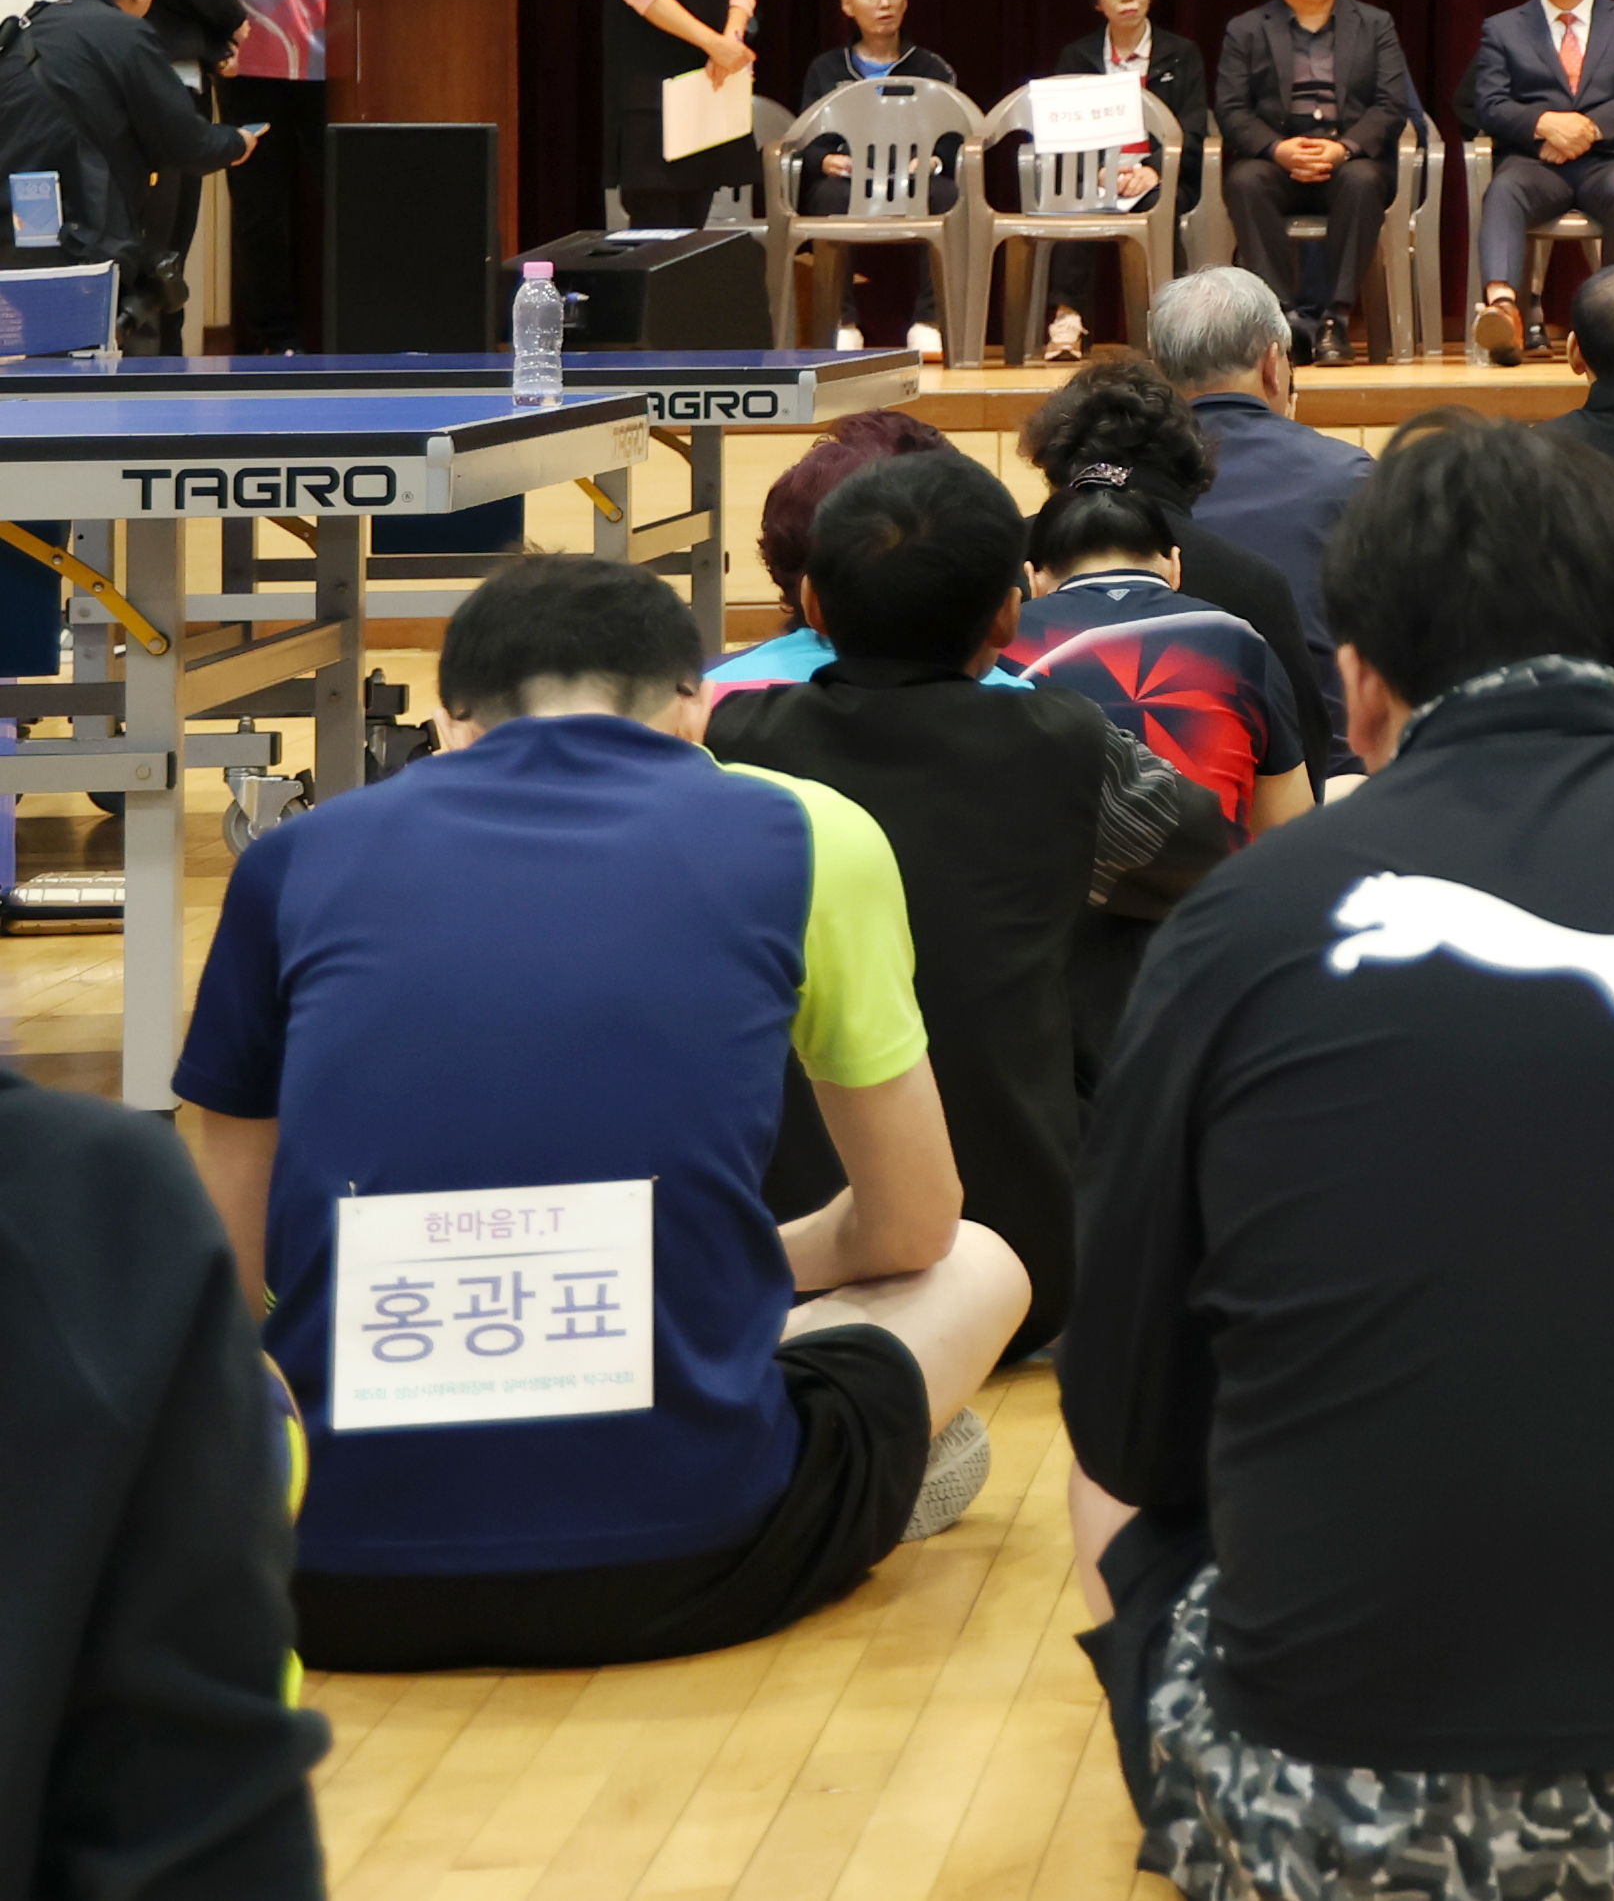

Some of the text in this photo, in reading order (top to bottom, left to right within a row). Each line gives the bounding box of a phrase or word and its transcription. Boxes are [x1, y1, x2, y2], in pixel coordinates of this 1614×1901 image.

[648, 390, 778, 420] AGRO
[122, 465, 397, 510] TAGRO
[424, 1207, 566, 1244] 한마음T.T
[361, 1270, 627, 1363] 홍광표
